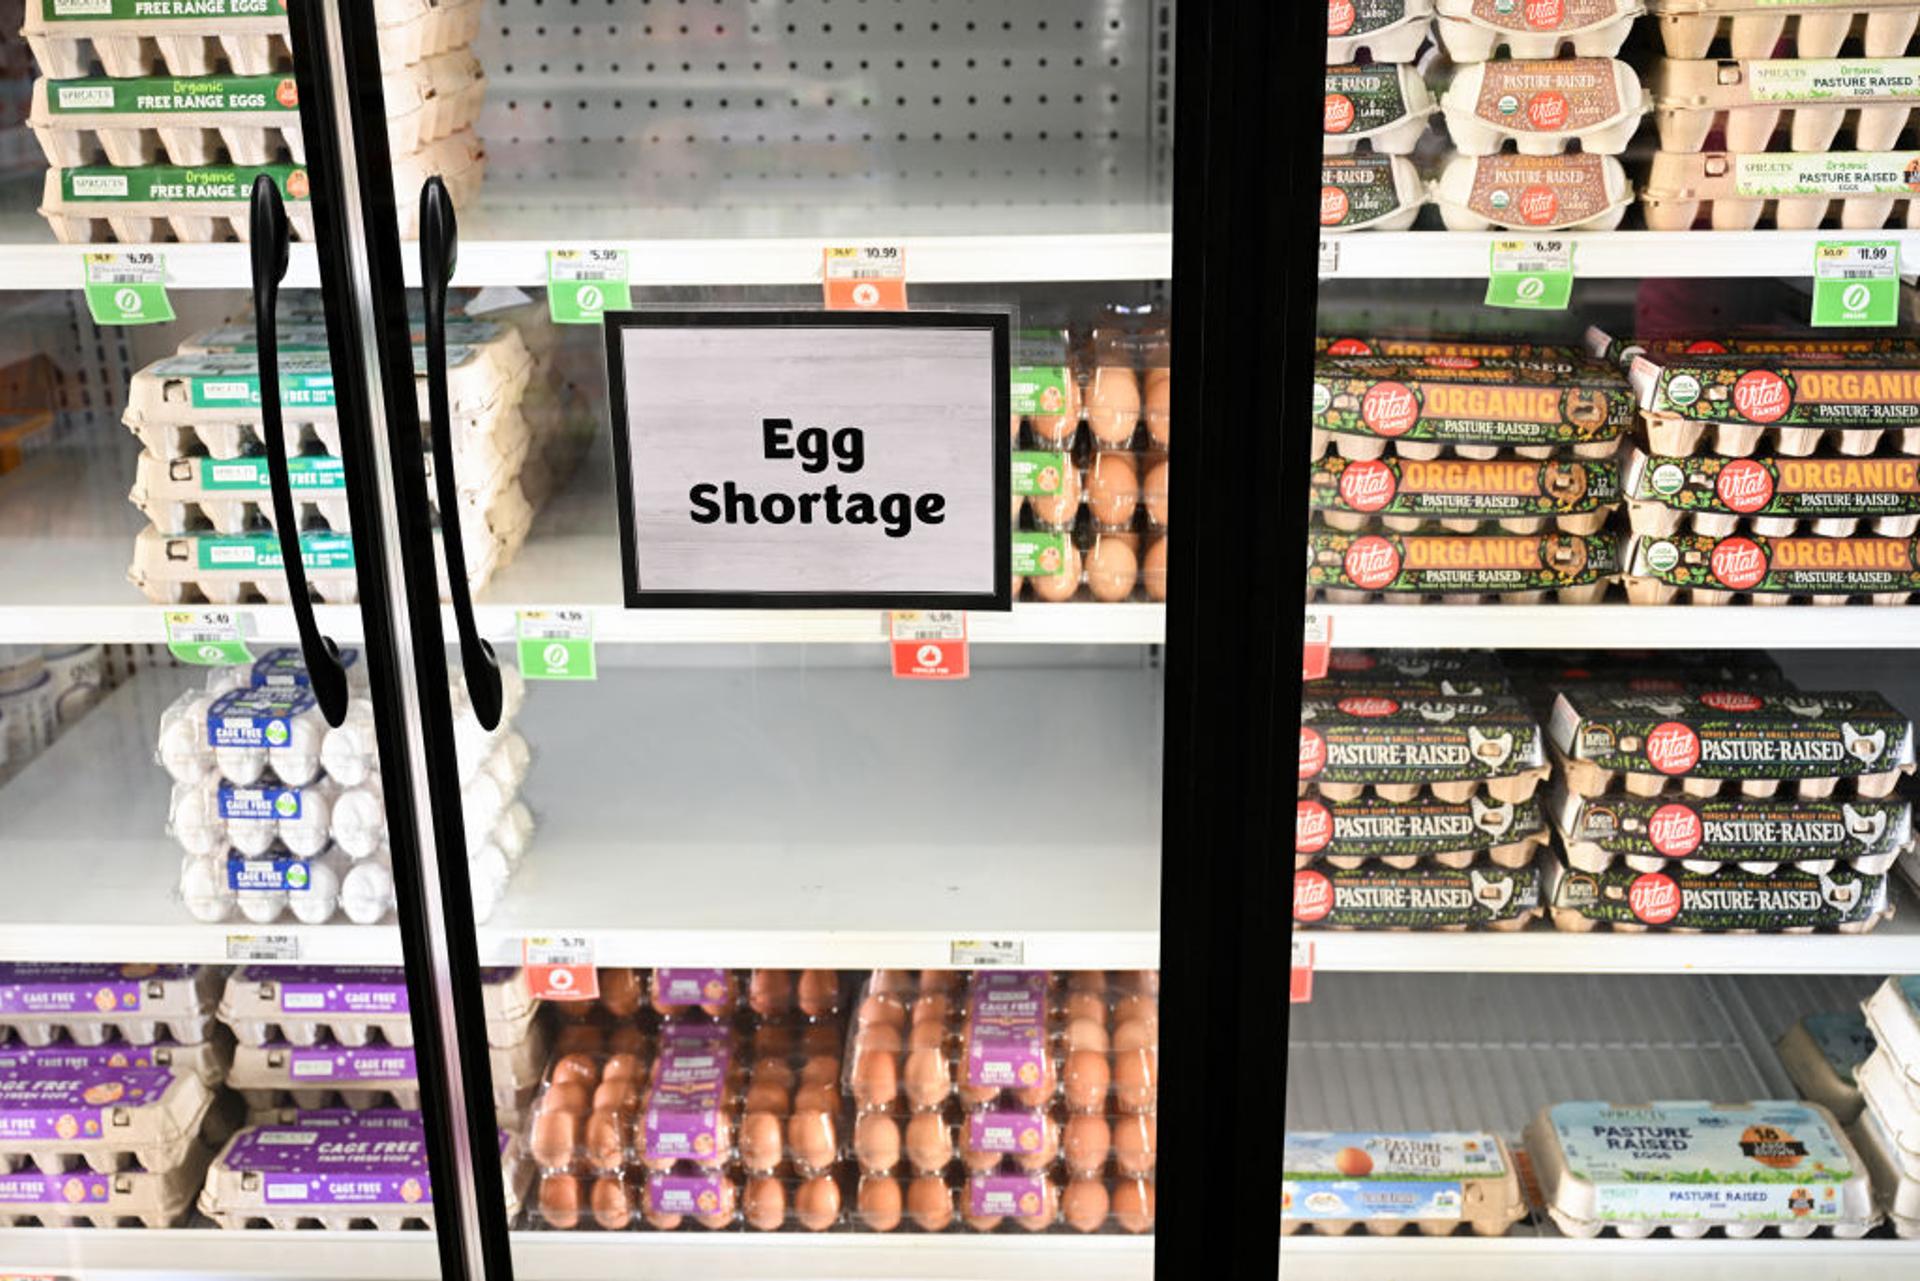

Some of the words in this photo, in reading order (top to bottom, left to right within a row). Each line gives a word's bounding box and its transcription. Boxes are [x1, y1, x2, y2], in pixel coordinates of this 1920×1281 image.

[135, 2, 170, 15] FREE
[174, 0, 225, 14] RANGE
[231, 0, 267, 12] EGGS
[173, 80, 223, 94] Organic
[1503, 74, 1595, 89] PASTURE-RAISED
[1813, 77, 1867, 88] PASTURE
[1869, 76, 1913, 87] RAISED
[137, 96, 171, 109] FREE
[174, 95, 224, 108] RANGE
[230, 93, 266, 107] EGGS
[186, 170, 235, 184] Organic
[1495, 170, 1584, 184] PASTURE-RAISED
[1800, 172, 1852, 183] PASTURE
[1854, 172, 1898, 183] RAISED
[150, 185, 183, 198] FREE
[186, 184, 235, 198] RANGE
[1735, 377, 1784, 410] Vital
[1364, 390, 1411, 421] Vital
[1429, 387, 1556, 419] ORGANIC
[1820, 404, 1919, 417] PASTURE-RAISED
[1444, 420, 1540, 436] PASTURE-RAISED
[762, 418, 865, 473] Egg
[1343, 467, 1388, 496] Vital
[1406, 463, 1535, 491] ORGANIC
[1719, 466, 1767, 497] Vital
[1785, 463, 1913, 489] ORGANIC
[1422, 494, 1519, 508] PASTURE-RAISED
[1801, 493, 1900, 506] PASTURE-RAISED
[689, 481, 946, 538] Shortage
[1348, 540, 1392, 569] Vital
[1409, 538, 1536, 565] ORGANIC
[1713, 543, 1760, 573] Vital
[1778, 541, 1905, 567] ORGANIC
[1426, 570, 1522, 583] PASTURE-RAISED
[1795, 571, 1892, 584] PASTURE-RAISED
[1649, 730, 1694, 760] Vital
[1702, 739, 1844, 761] PASTURE-RAISED
[1327, 744, 1471, 765] PASTURE-RAISED
[1334, 815, 1473, 838] PASTURE-RAISED
[1651, 812, 1695, 844] Vital
[1703, 821, 1845, 842] PASTURE-RAISED
[1335, 887, 1473, 909] PASTURE-RAISED
[1631, 880, 1675, 911] Vital
[1682, 890, 1822, 910] PASTURE-RAISED
[23, 992, 49, 1003] CAGE
[51, 992, 75, 1003] FREE
[344, 992, 370, 1004] CAGE
[373, 992, 396, 1003] FREE
[354, 1059, 379, 1070] CAGE
[382, 1058, 405, 1070] FREE
[32, 1080, 83, 1090] FREE
[11, 1118, 36, 1129] FREE
[1592, 1125, 1693, 1139] PASTURE
[318, 1142, 370, 1154] CAGE
[373, 1141, 420, 1153] FREE
[1384, 1138, 1442, 1150] PASTURE
[1607, 1138, 1688, 1151] RAISED
[20, 1181, 44, 1192] FREE
[329, 1183, 355, 1194] CAGE
[357, 1182, 381, 1193] FREE
[1669, 1191, 1720, 1201] PASTURE
[1726, 1191, 1768, 1202] RAISED
